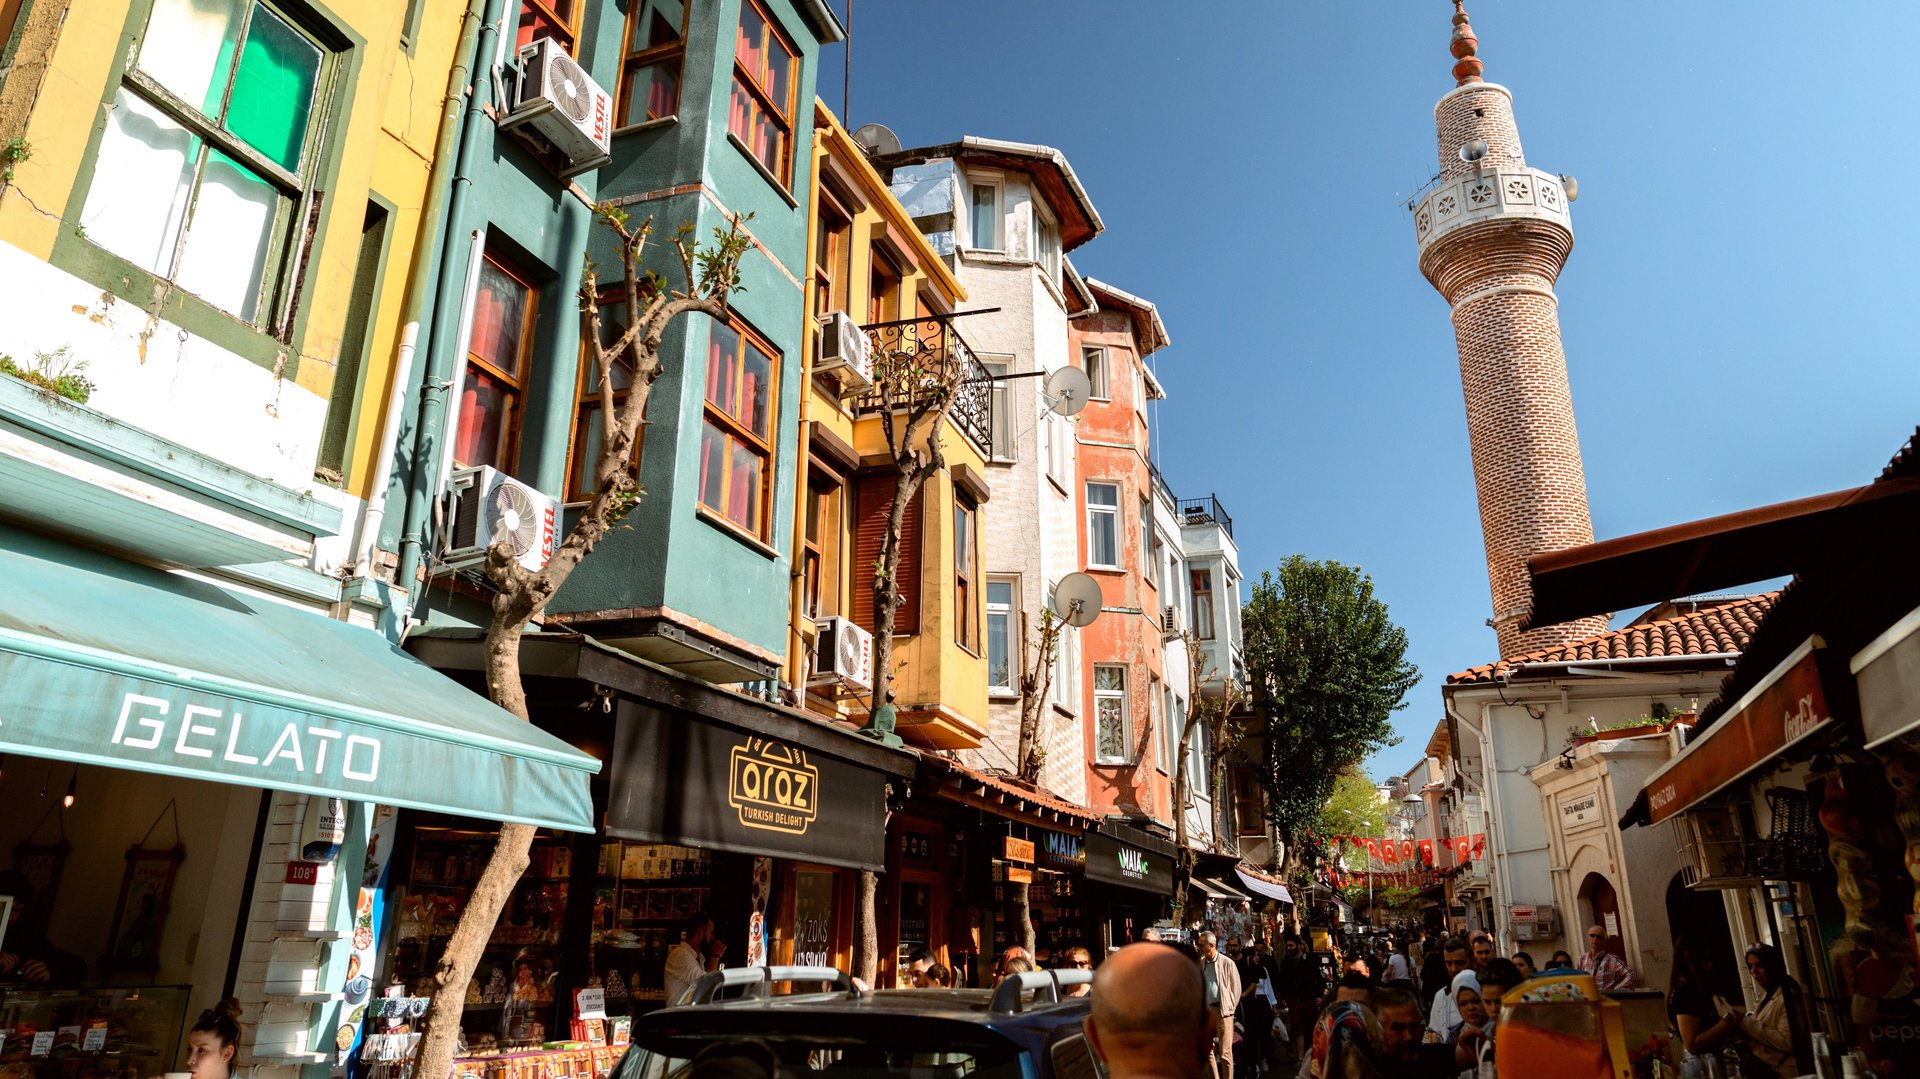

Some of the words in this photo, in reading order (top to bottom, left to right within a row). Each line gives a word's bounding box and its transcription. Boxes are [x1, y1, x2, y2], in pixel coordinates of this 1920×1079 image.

[594, 93, 606, 141] VESTEL
[540, 506, 554, 567] VESTEL
[111, 692, 381, 783] GELATO
[742, 762, 808, 808] araz
[320, 816, 344, 825] INTECH
[744, 806, 774, 822] TURKISH
[775, 812, 803, 827] DELIGHT
[1049, 832, 1078, 858] MAIA
[1121, 847, 1142, 873] MAIA
[1122, 869, 1143, 879] COSMETICS
